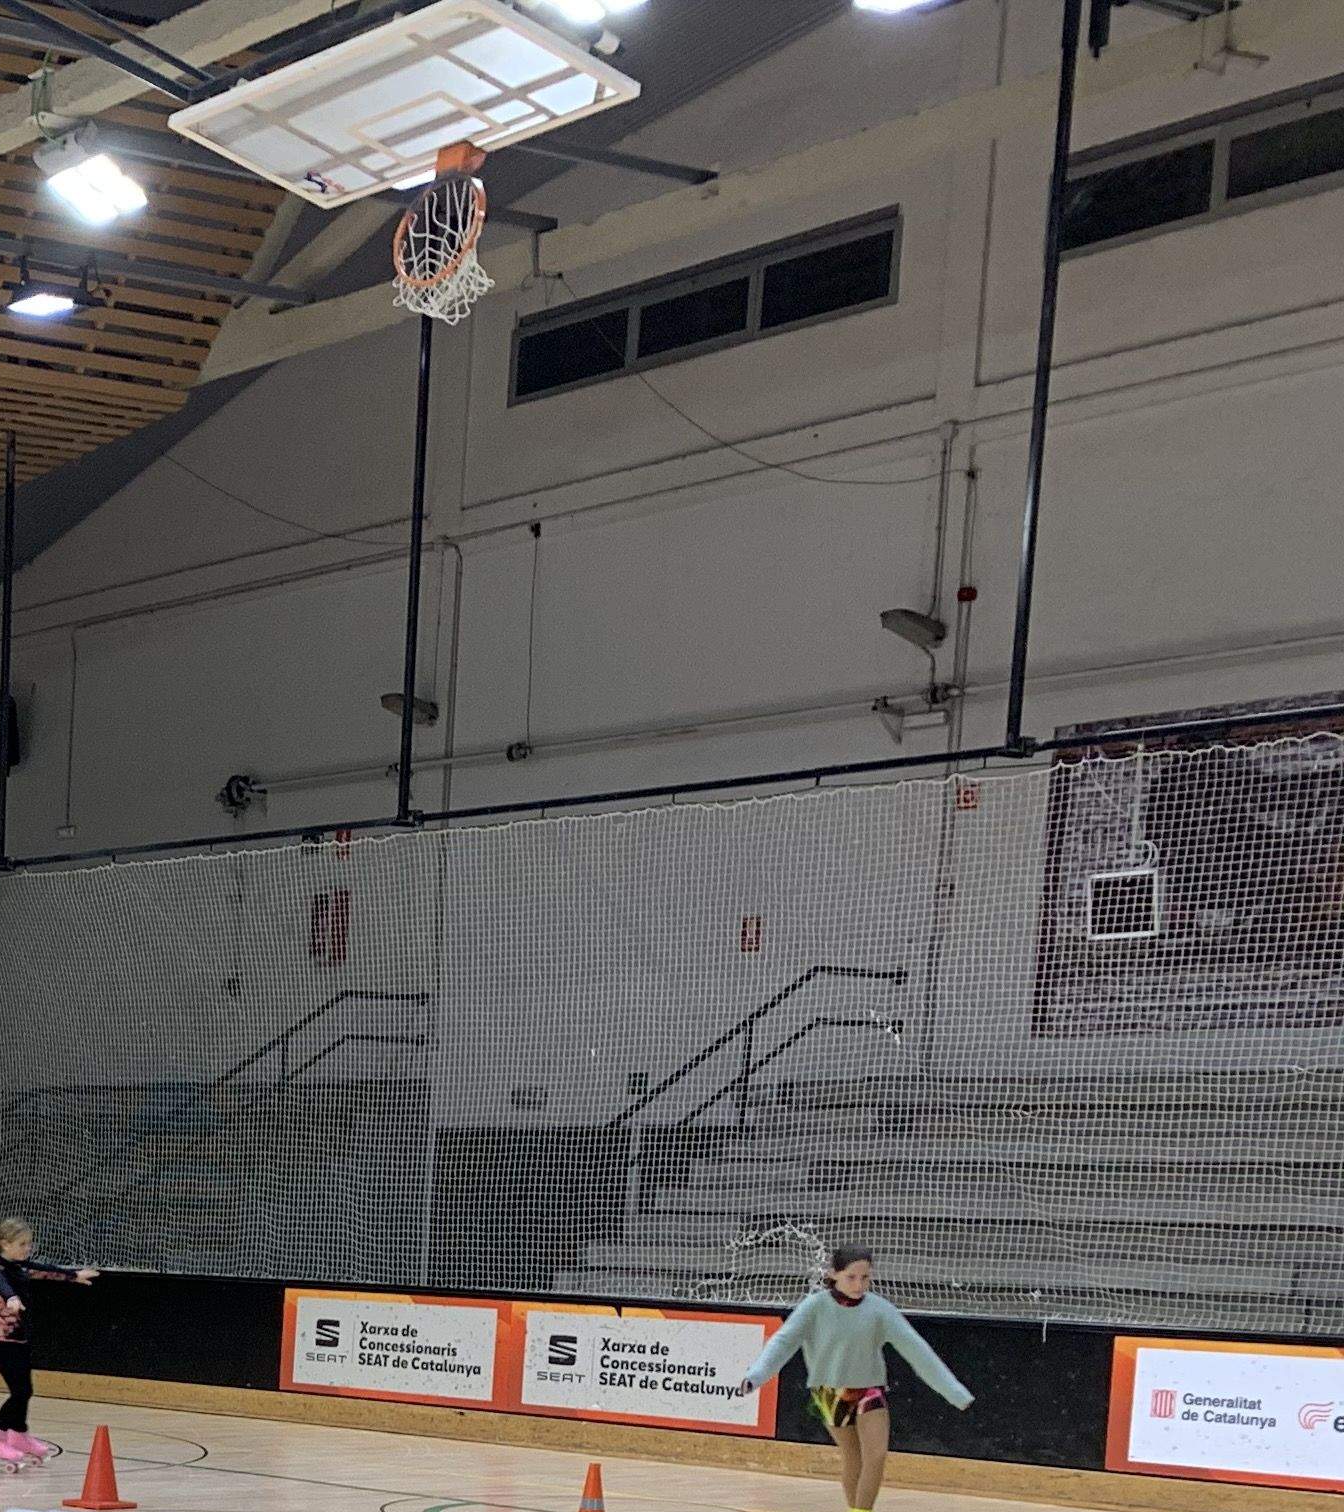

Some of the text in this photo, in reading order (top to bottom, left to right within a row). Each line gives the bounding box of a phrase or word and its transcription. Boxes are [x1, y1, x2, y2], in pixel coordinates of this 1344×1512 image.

[360, 1321, 418, 1338] Xarxa de
[359, 1337, 457, 1357] Concessionaris
[601, 1337, 670, 1356] Xarxa de
[305, 1351, 348, 1364] SEAT
[358, 1352, 481, 1378] SEAT de Catalunya
[600, 1355, 716, 1378] Concessionaris
[536, 1370, 586, 1384] SEAT
[599, 1371, 745, 1401] SEAT de Catalunya
[1182, 1392, 1262, 1411] Generalitat
[1181, 1409, 1277, 1430] de Catalunya
